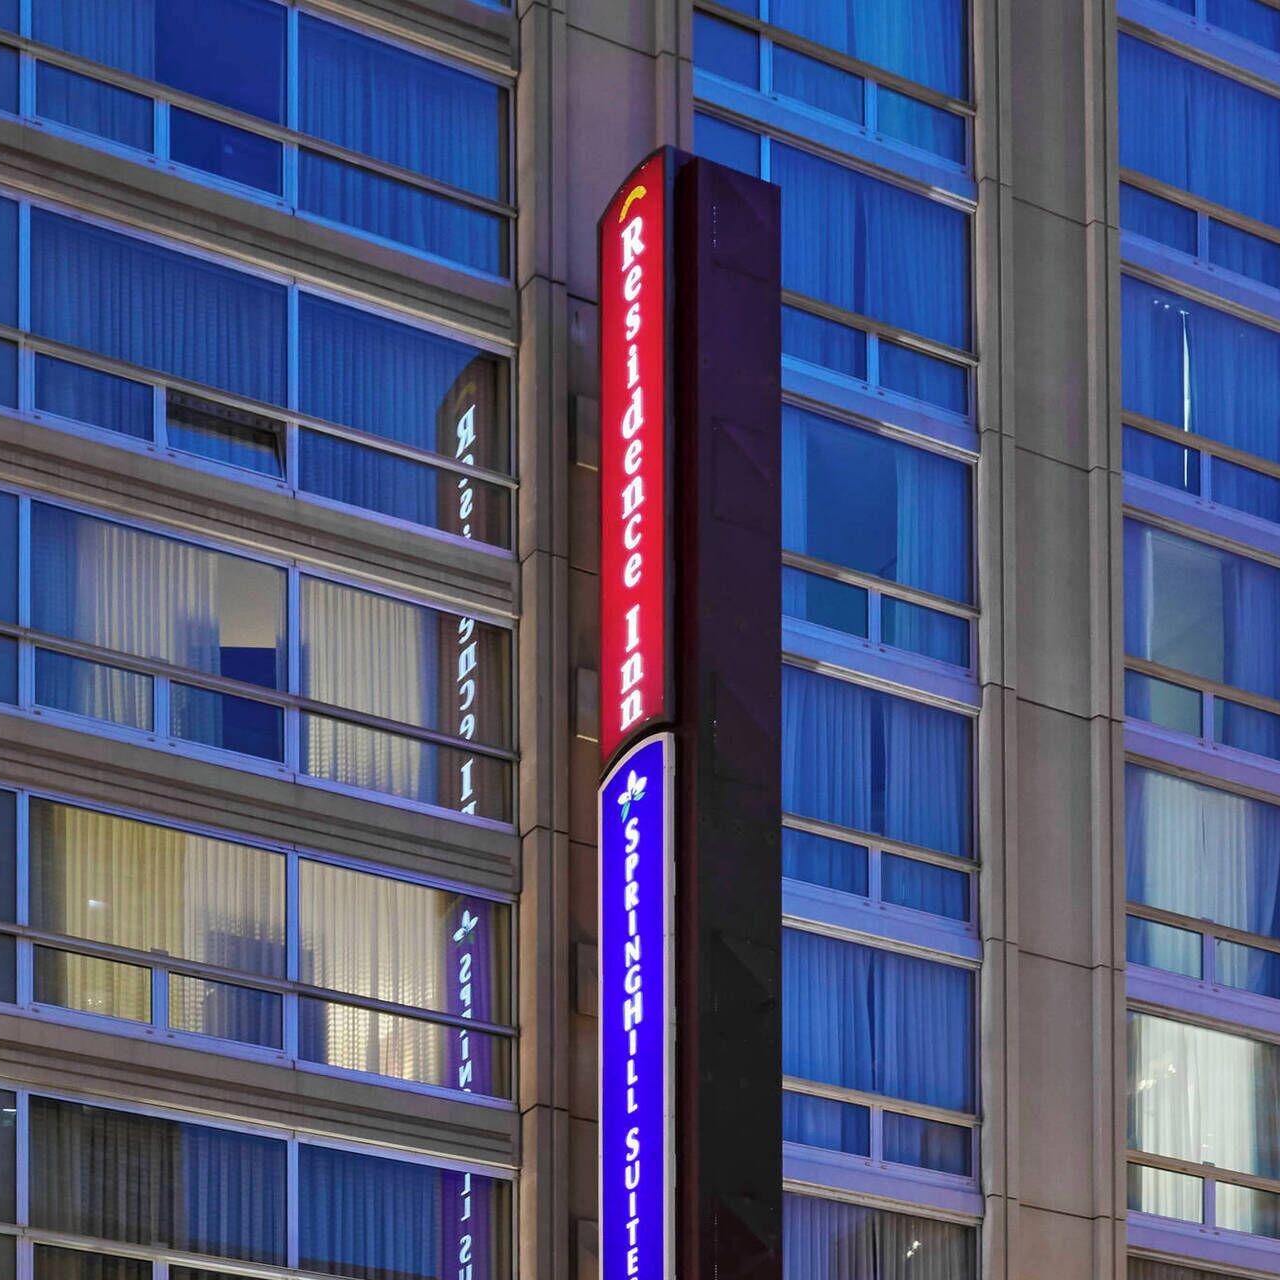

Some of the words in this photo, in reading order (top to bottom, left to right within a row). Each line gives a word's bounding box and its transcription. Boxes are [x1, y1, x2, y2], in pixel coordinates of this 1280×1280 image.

[619, 217, 646, 588] Residence
[619, 604, 644, 731] Inn
[622, 817, 643, 1114] SPRINGHILL
